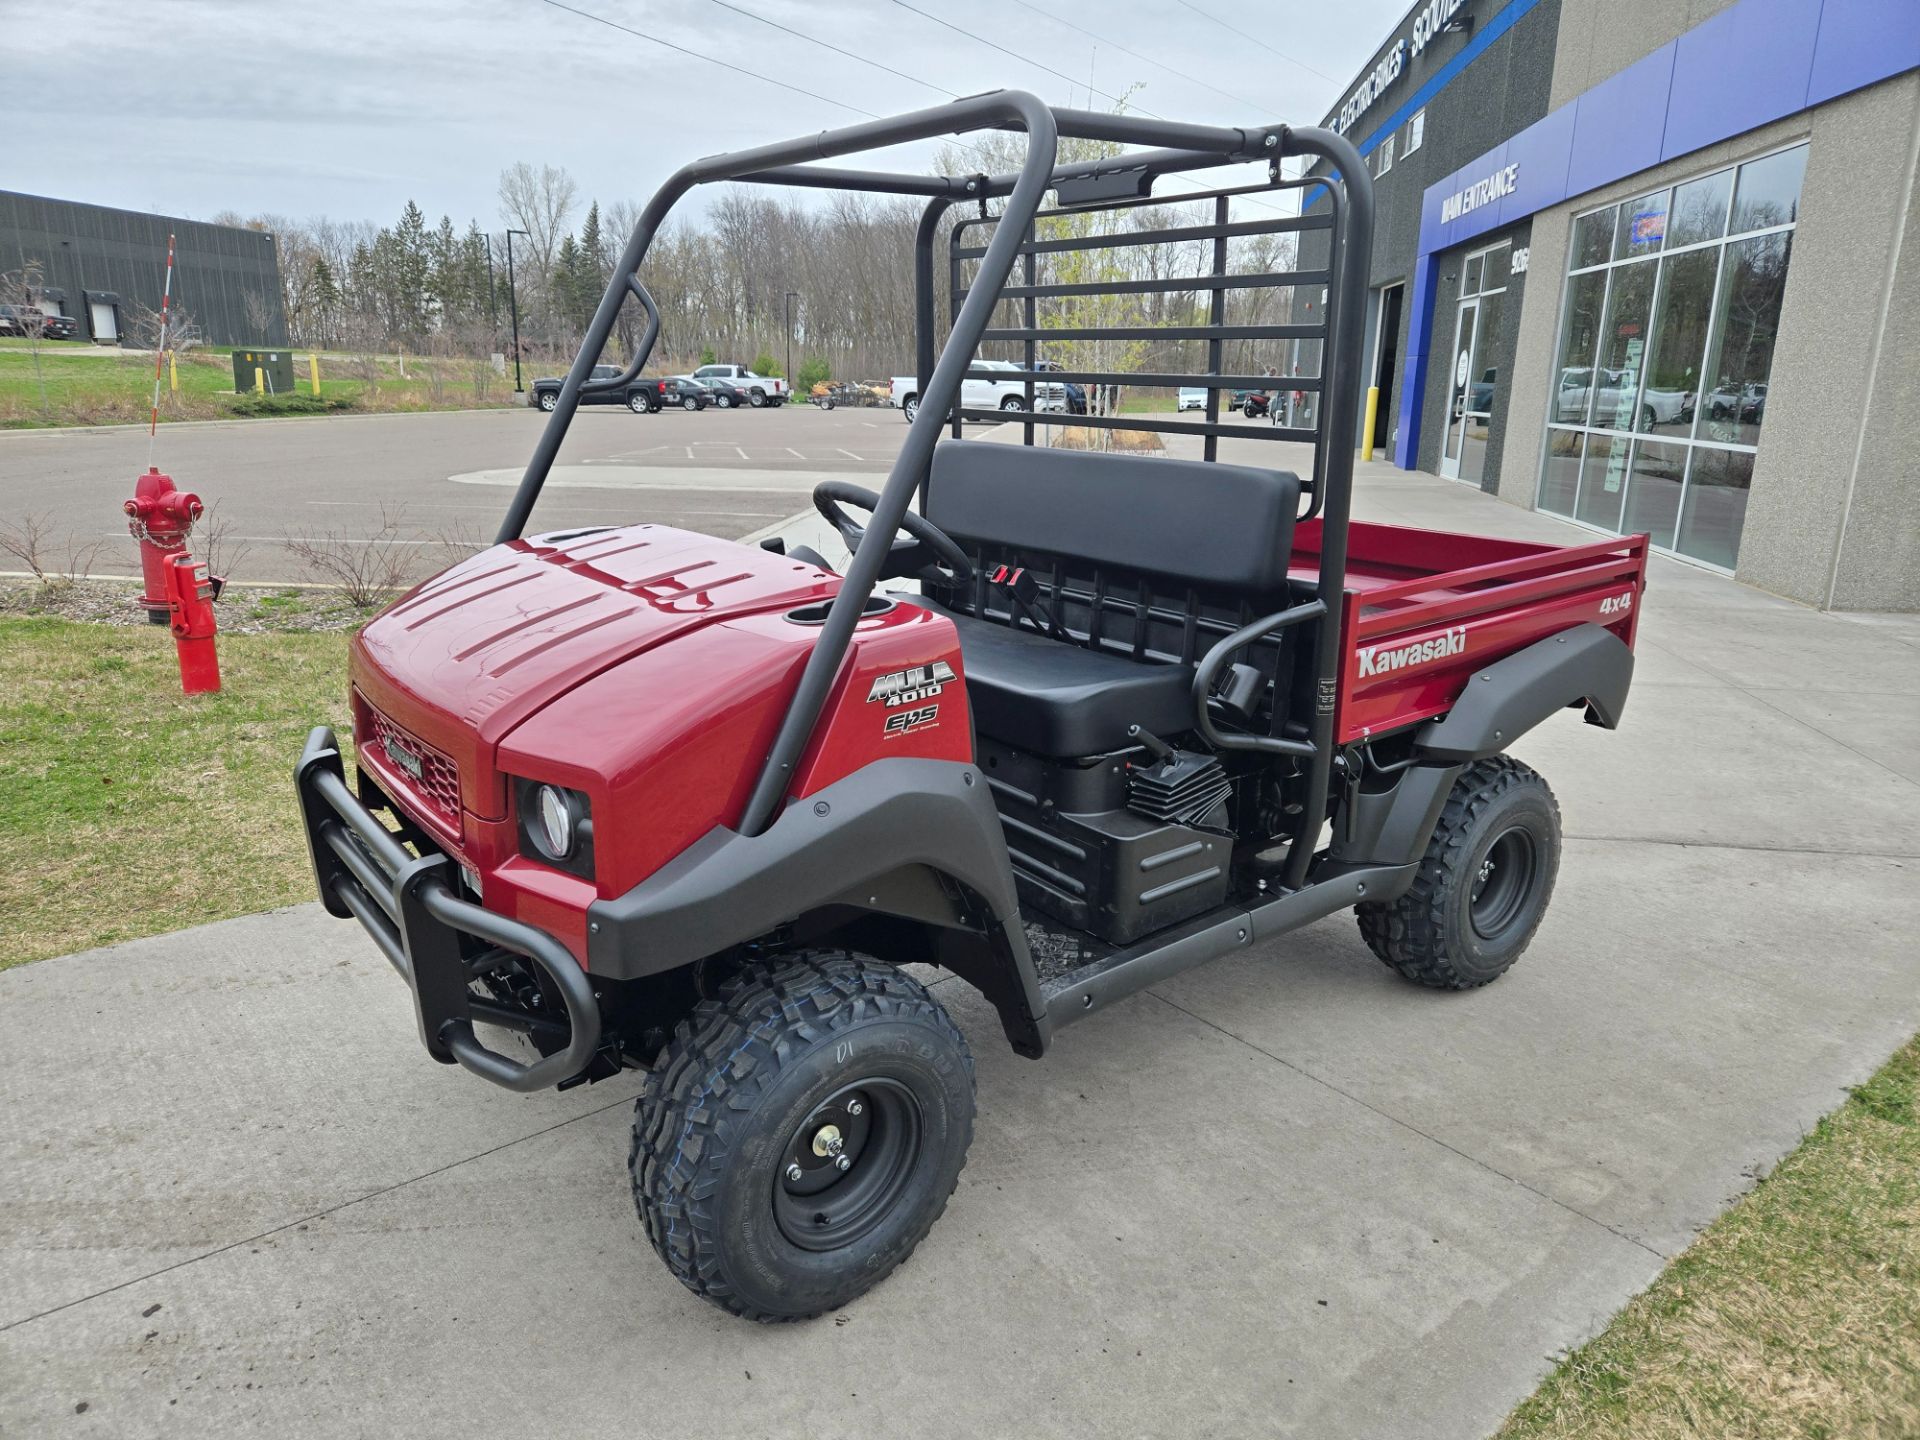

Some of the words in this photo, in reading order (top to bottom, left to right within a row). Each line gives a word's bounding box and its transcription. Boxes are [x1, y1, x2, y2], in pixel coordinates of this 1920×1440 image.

[1338, 71, 1376, 135] ELECTRIC
[1374, 38, 1405, 100] BIKES
[1441, 191, 1464, 224] MAIN
[1462, 162, 1520, 214] ENTRANCE
[1511, 248, 1530, 275] 926
[1599, 591, 1631, 615] 4x4
[1358, 625, 1466, 679] Kawasaki
[885, 684, 942, 707] 4010
[884, 704, 939, 732] EPS
